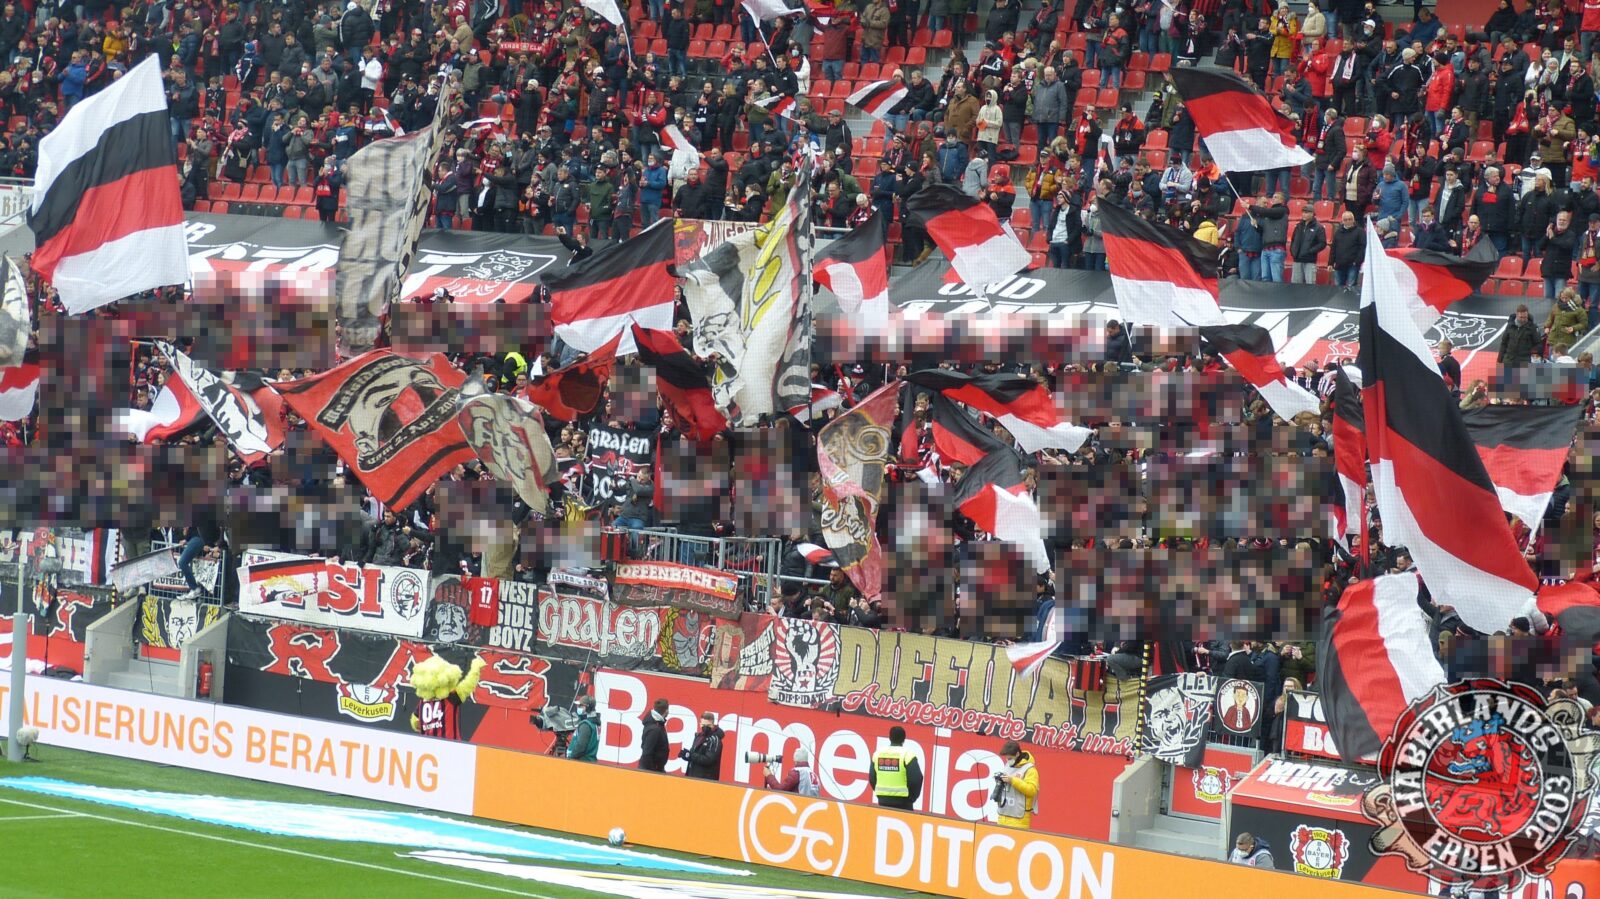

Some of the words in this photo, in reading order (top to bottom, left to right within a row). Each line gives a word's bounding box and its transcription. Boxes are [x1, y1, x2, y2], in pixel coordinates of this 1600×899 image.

[480, 586, 493, 605] 17
[498, 580, 537, 606] WEST
[488, 626, 533, 652] BOYZ
[343, 700, 390, 717] Leverkusen
[422, 701, 444, 723] 04
[842, 683, 1027, 742] Ausgesperrte
[1033, 722, 1078, 750] mit
[245, 731, 439, 793] BERATUNG
[873, 815, 1115, 899] DITCON
[1298, 864, 1337, 877] Leverkusen
